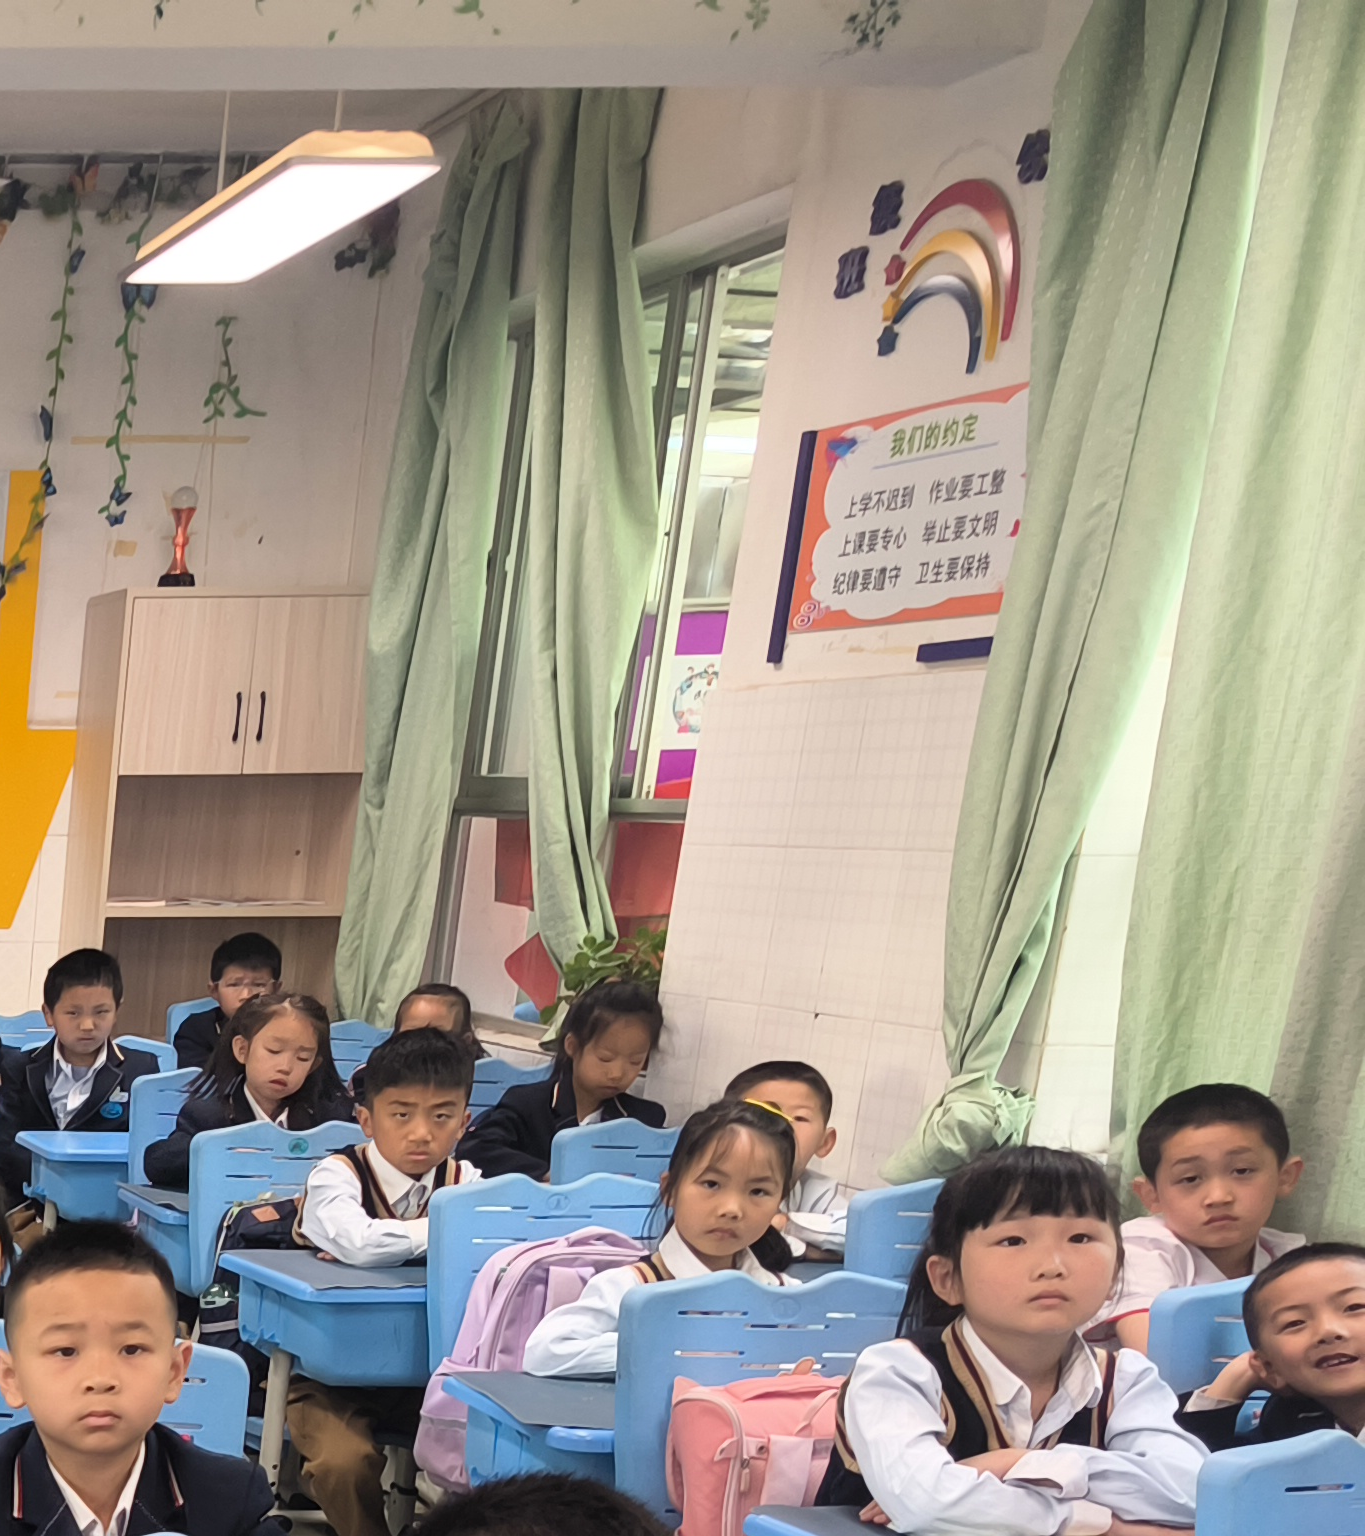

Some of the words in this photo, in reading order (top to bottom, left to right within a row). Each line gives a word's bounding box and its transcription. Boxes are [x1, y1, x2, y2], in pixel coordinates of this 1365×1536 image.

[889, 412, 979, 459] 我们的约定
[843, 483, 916, 520] 上学不迟到
[928, 466, 1007, 505] 作业要工整
[837, 525, 908, 558] 上课要专心
[921, 509, 1000, 546] 举止要文明
[831, 563, 902, 596] 纪律要遵守
[914, 551, 991, 585] 卫生要保持
